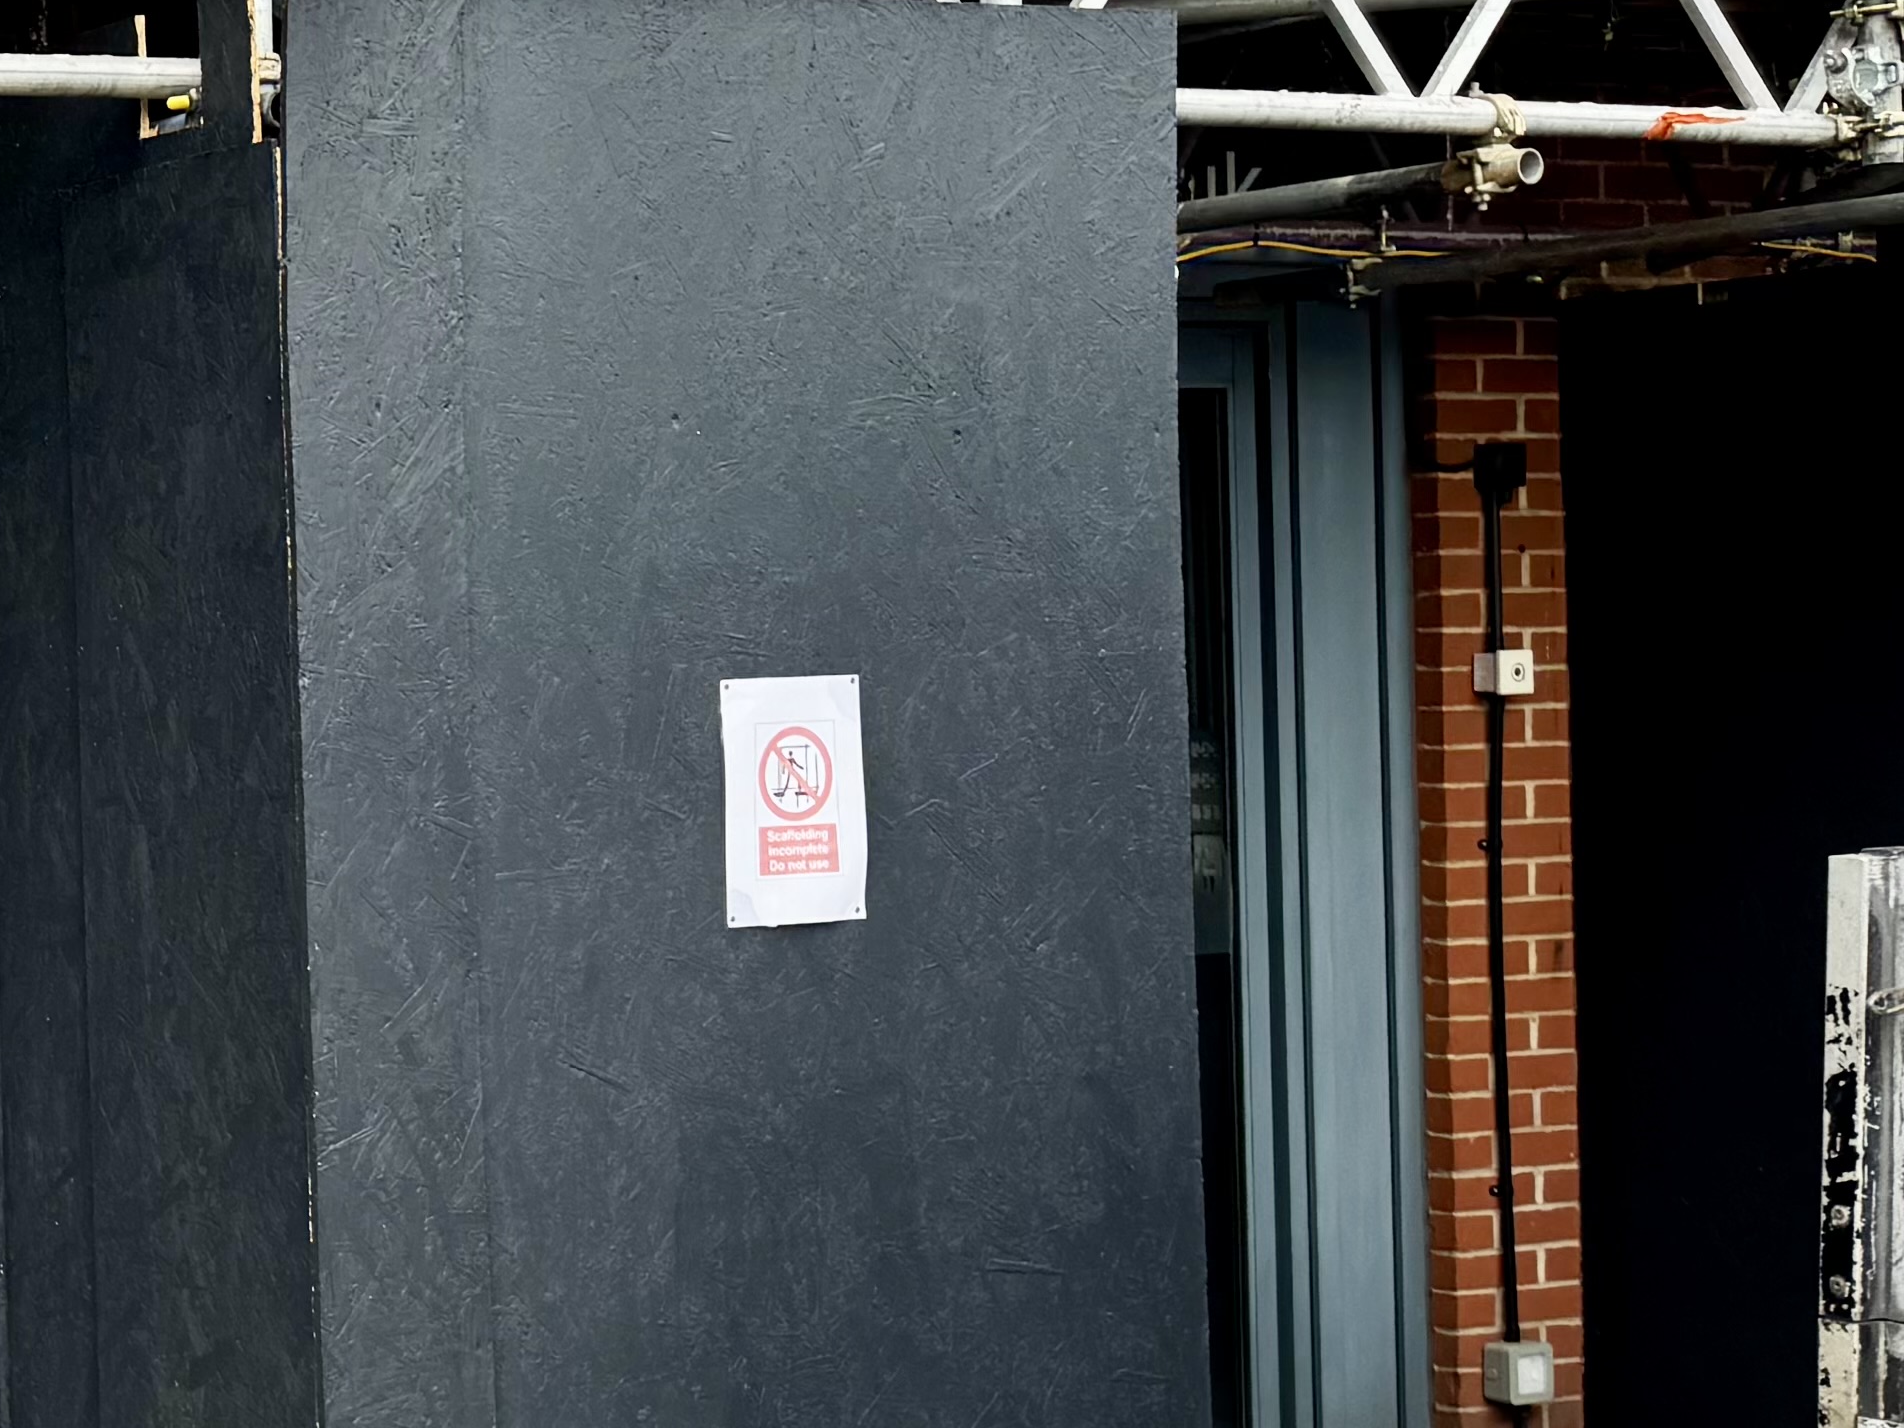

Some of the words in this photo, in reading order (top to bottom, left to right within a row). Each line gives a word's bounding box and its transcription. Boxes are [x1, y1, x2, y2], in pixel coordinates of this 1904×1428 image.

[766, 827, 829, 843] Scaffolding
[769, 859, 785, 872] Do
[787, 859, 807, 872] not
[808, 858, 830, 870] use
